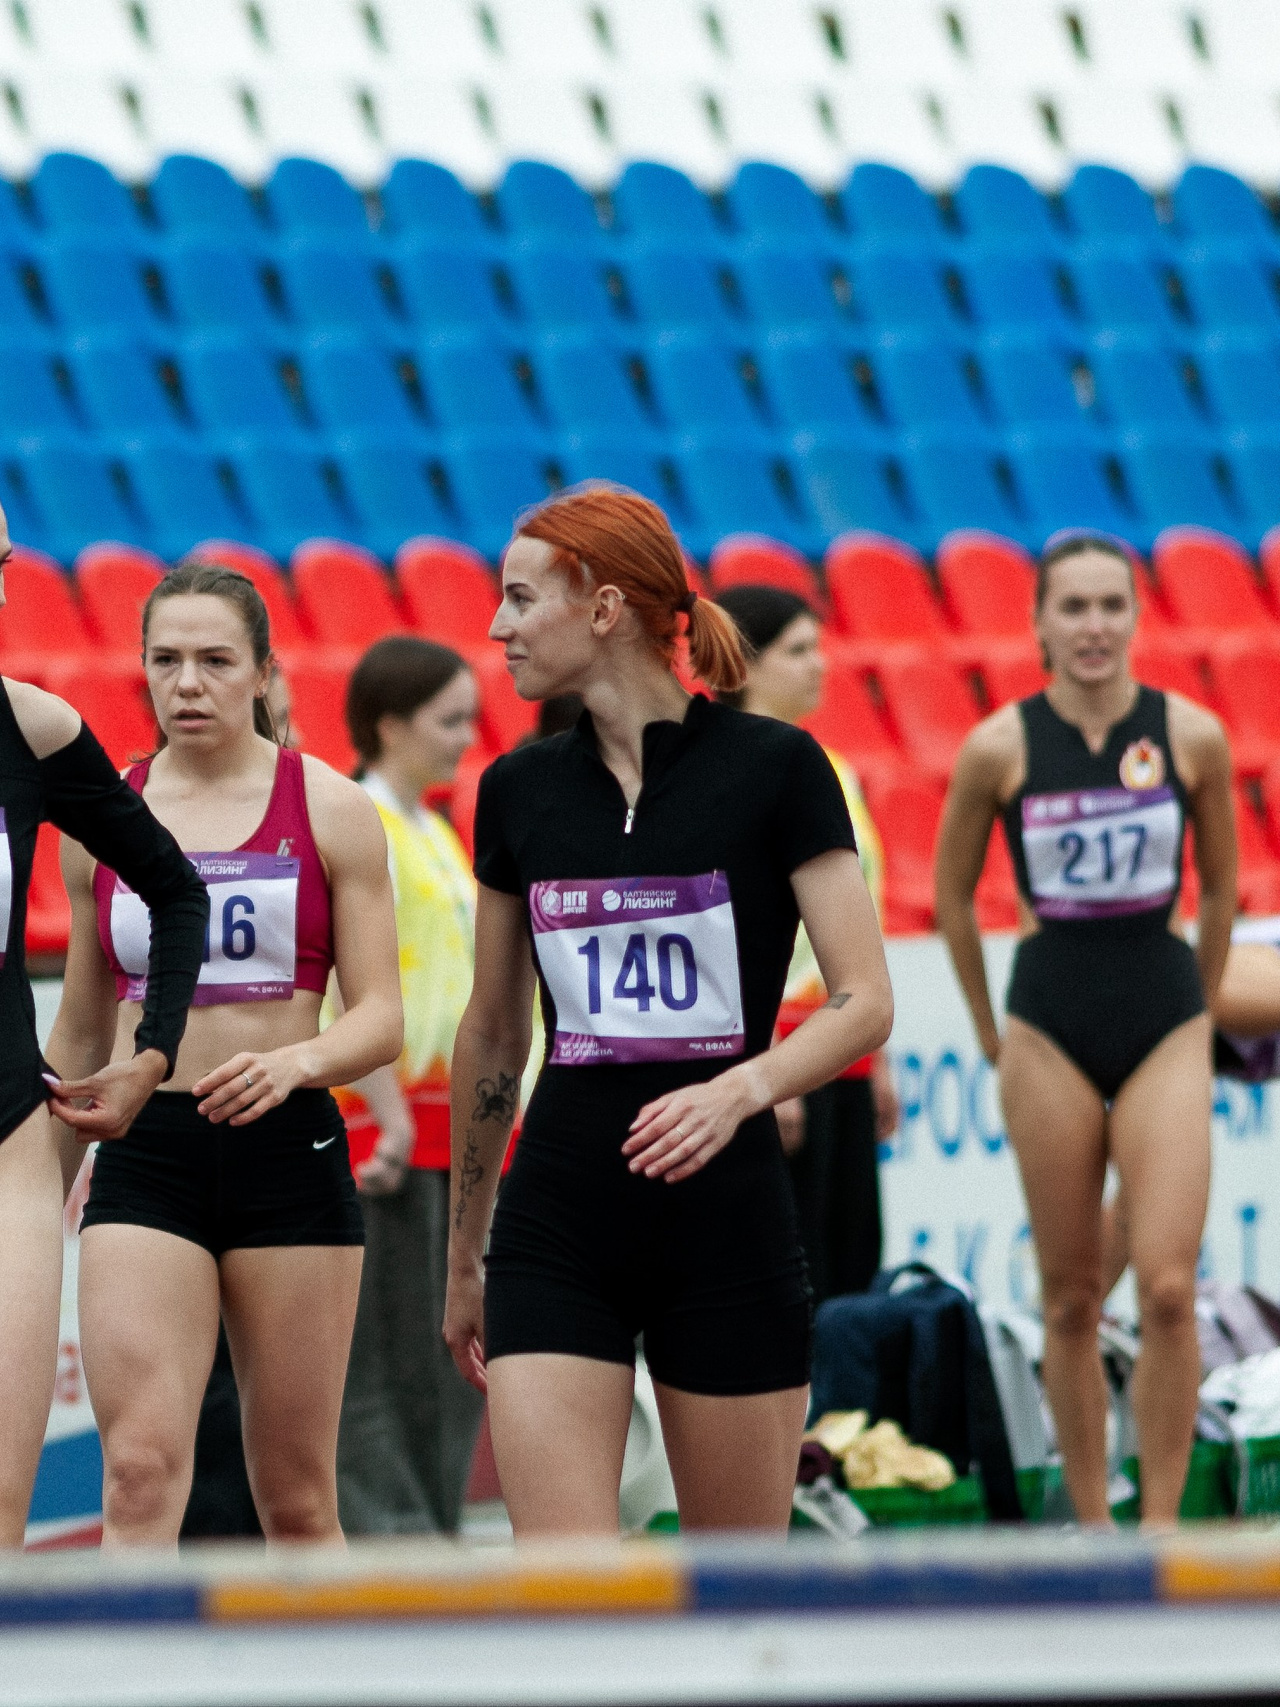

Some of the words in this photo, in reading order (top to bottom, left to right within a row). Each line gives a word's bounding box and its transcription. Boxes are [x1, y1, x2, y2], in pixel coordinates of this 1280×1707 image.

[198, 864, 247, 876] ЛИЗИНГ
[1056, 823, 1148, 886] 217
[622, 897, 677, 911] ЛИЗИНГ
[577, 933, 698, 1014] 140
